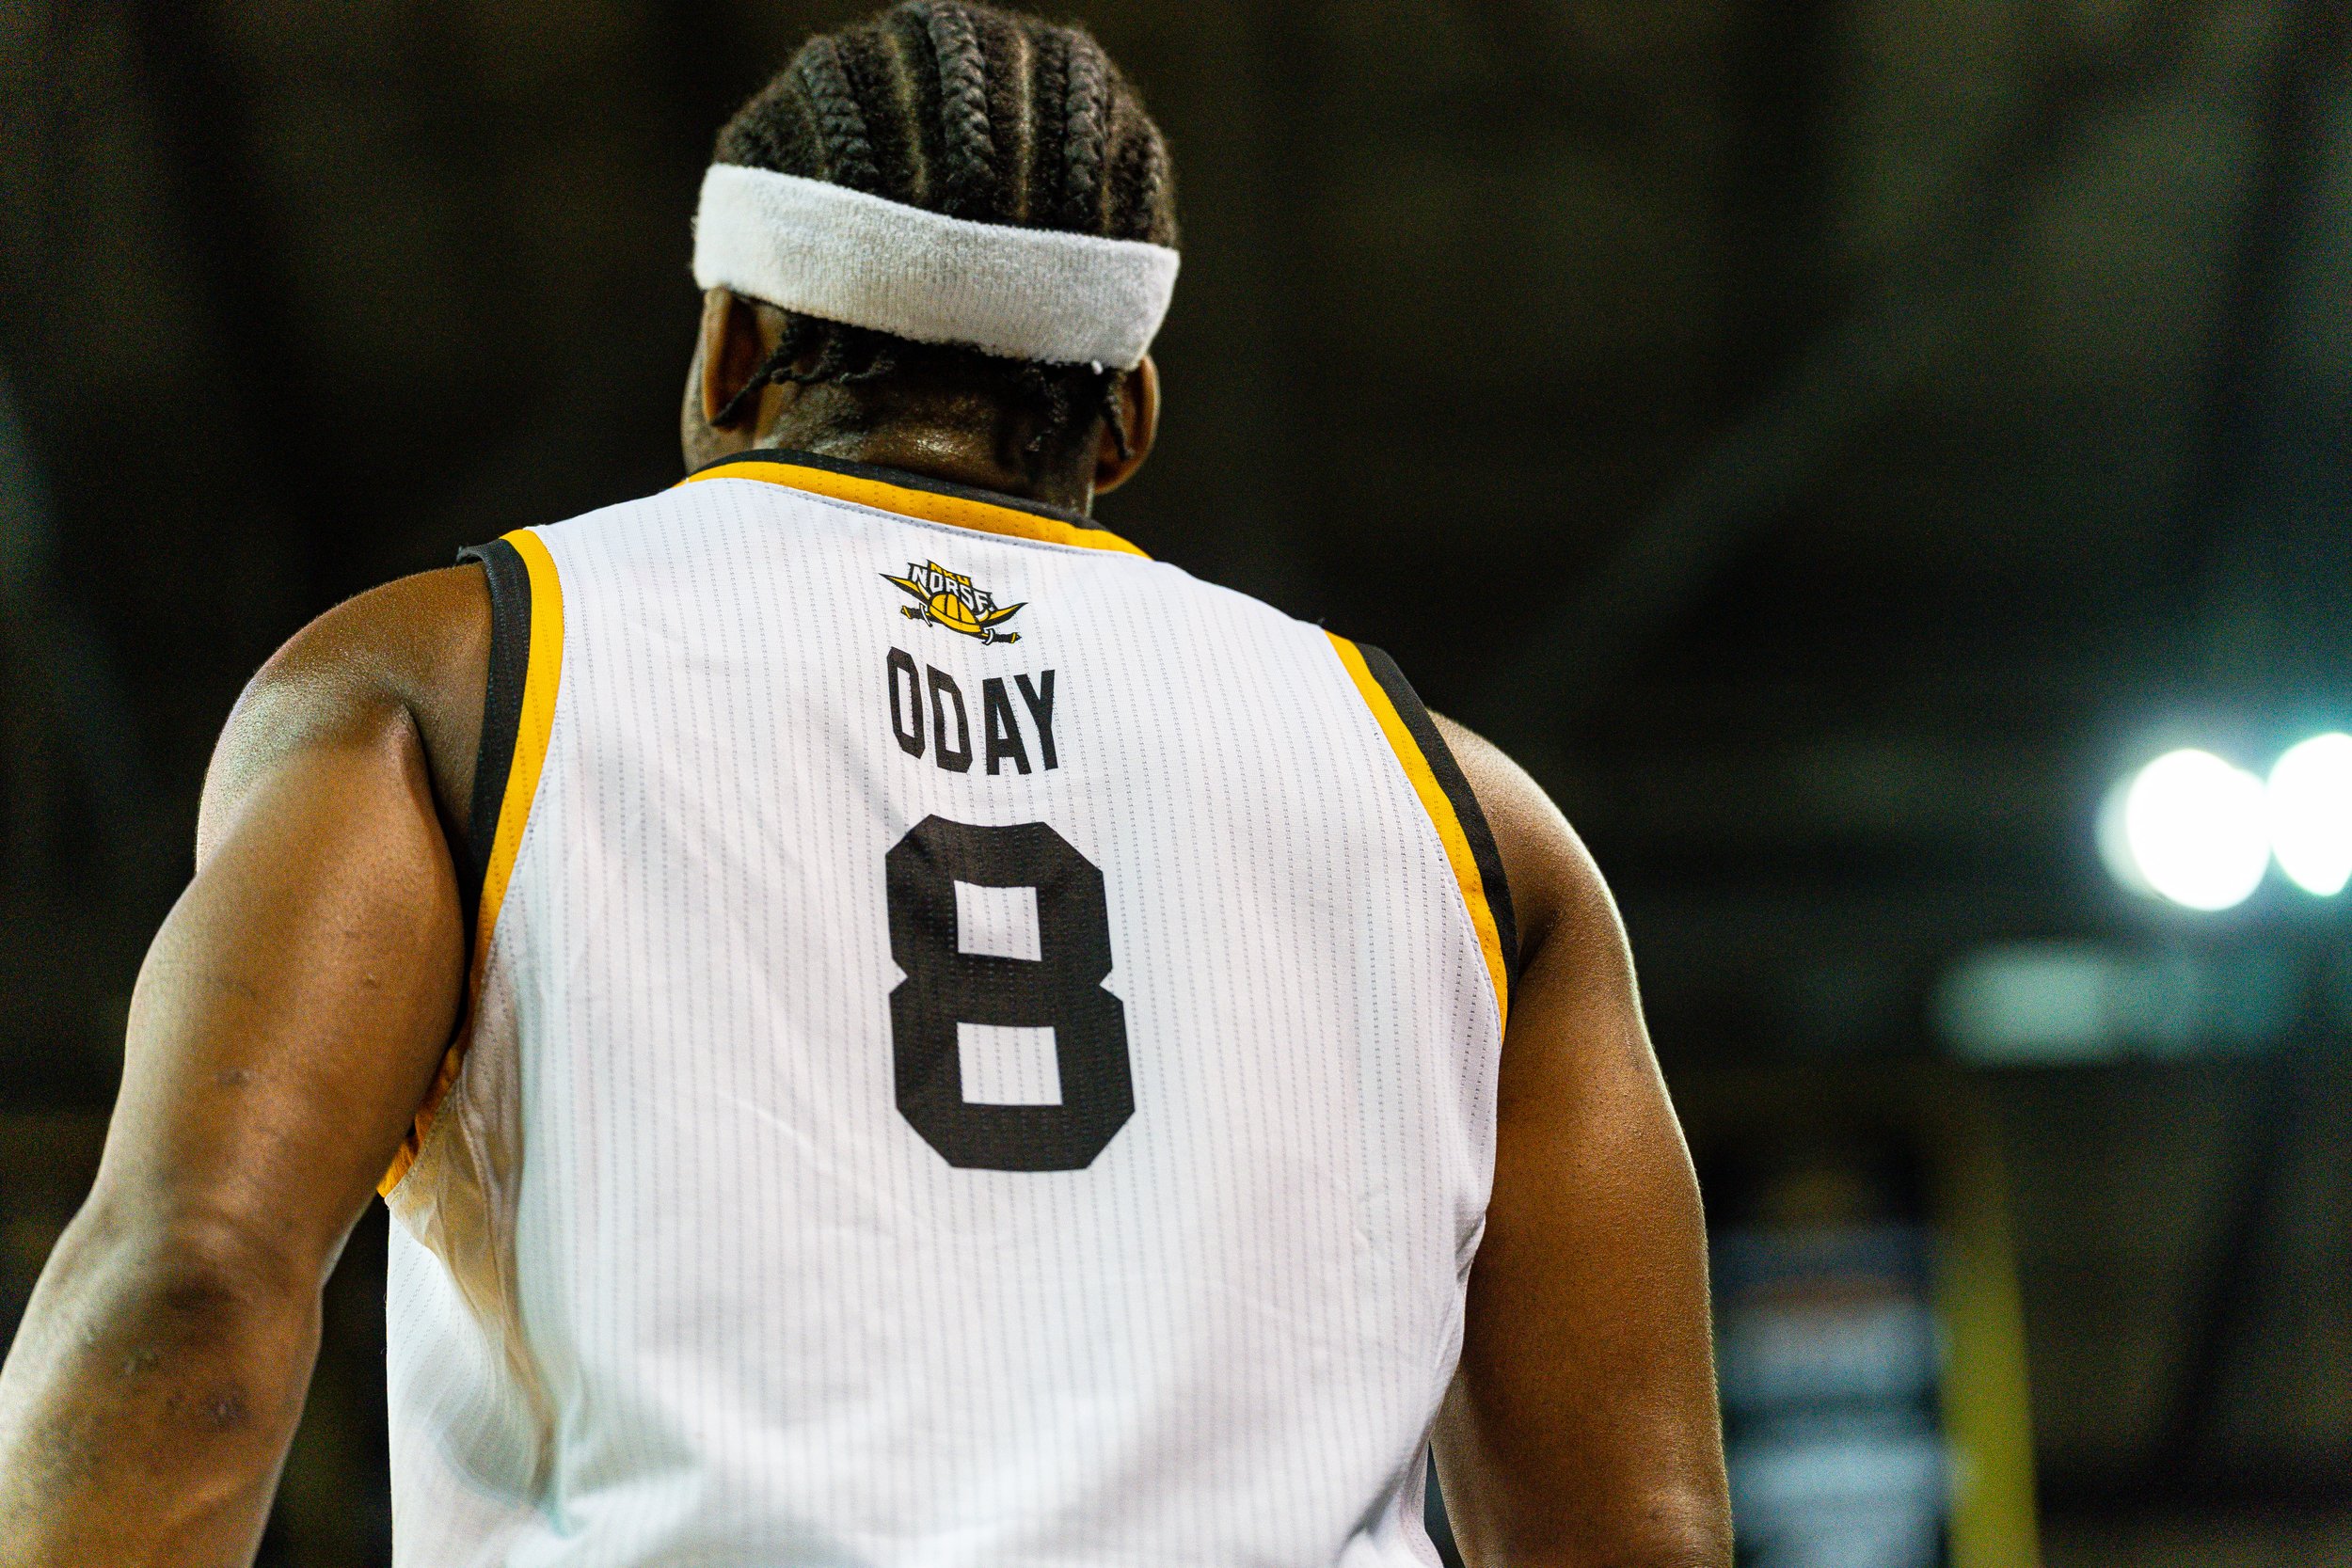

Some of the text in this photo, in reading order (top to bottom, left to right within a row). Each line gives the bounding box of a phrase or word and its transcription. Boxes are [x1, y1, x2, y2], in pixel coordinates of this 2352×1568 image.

[911, 565, 995, 612] NORSE
[930, 562, 970, 586] NKU
[886, 646, 1059, 776] ODAY
[885, 814, 1136, 1172] 8
